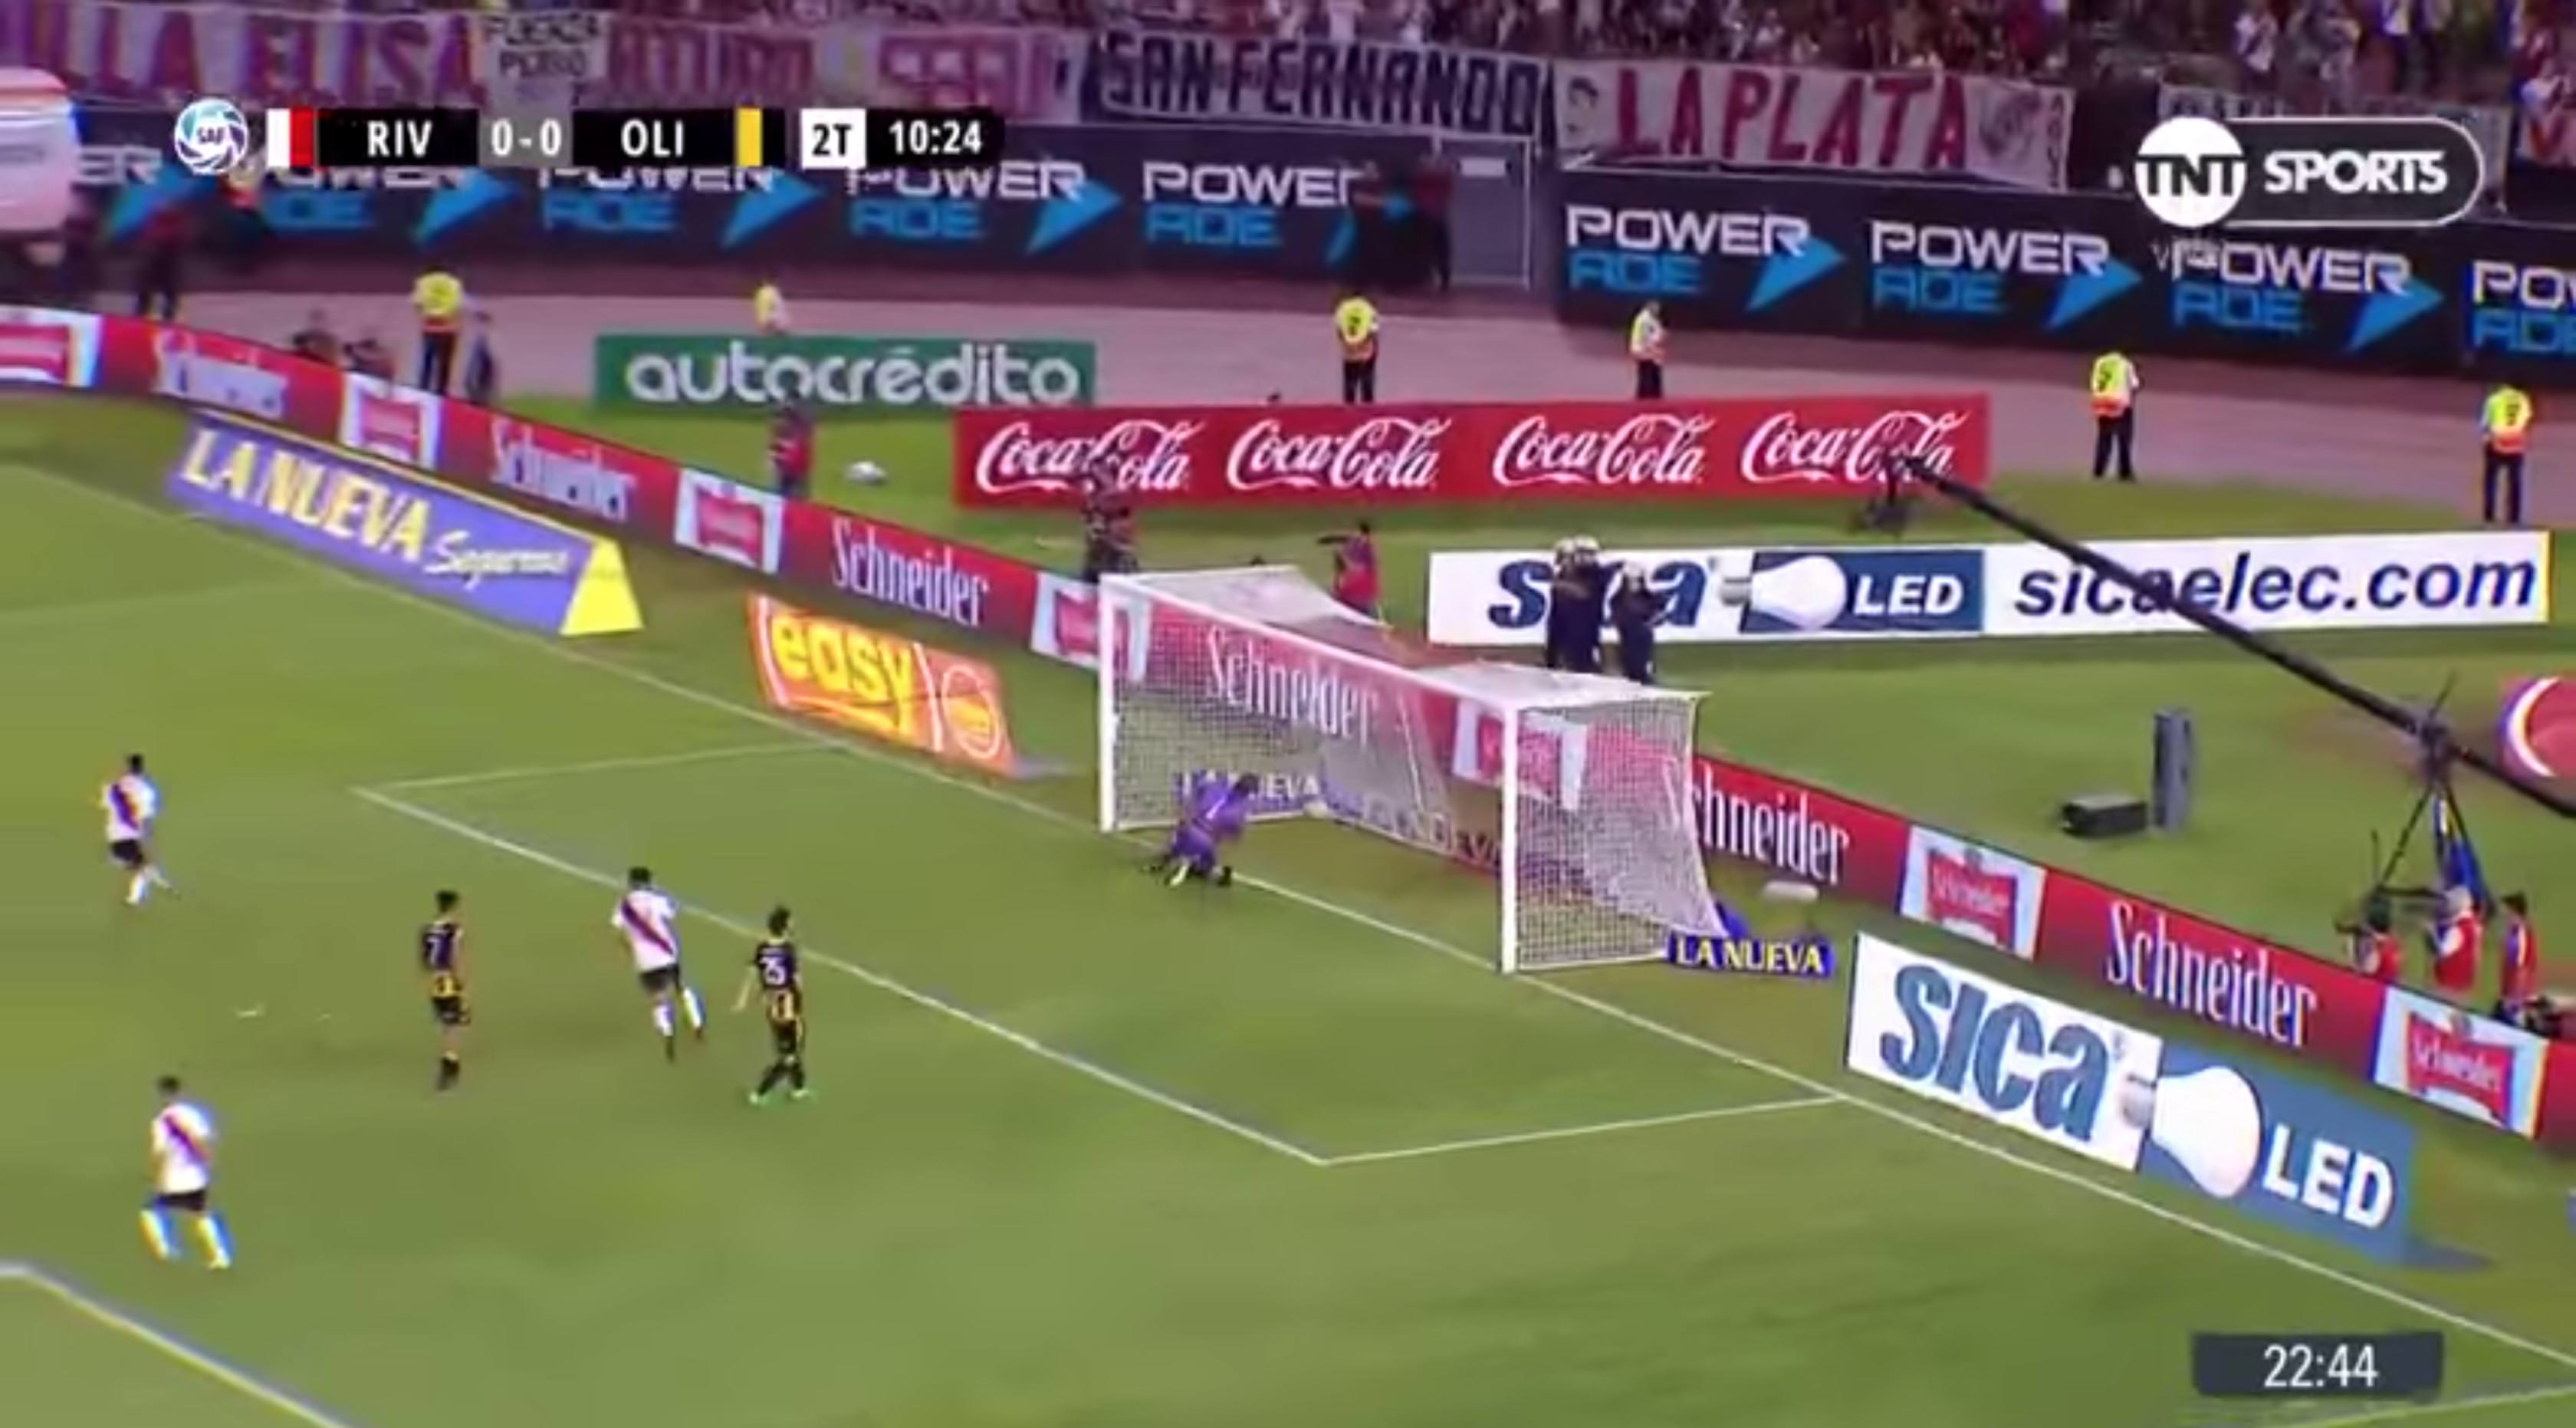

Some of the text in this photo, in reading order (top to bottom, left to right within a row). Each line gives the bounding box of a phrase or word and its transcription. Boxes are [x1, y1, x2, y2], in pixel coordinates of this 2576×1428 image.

[1228, 37, 1536, 135] FERNANDO
[1720, 71, 1966, 167] PLATA
[848, 160, 1085, 202] POWER
[1566, 205, 1811, 257] POWER
[1872, 220, 2110, 276] POWER
[2171, 236, 2411, 296] POWER
[625, 341, 1081, 403] autocrédito
[1227, 417, 1451, 491] Coca-Cola
[1492, 413, 1714, 486] Coca-Cola
[181, 428, 258, 500] LA
[256, 449, 432, 563] NUEVA
[830, 517, 991, 626] Schneider
[1852, 575, 1963, 614] LED
[2015, 552, 2539, 615] sicaelec.com
[771, 614, 914, 736] easy
[1207, 624, 1377, 745] Schneider
[1676, 939, 1823, 974] LA NUEVA
[2107, 902, 2318, 1048] Schneider
[2262, 1123, 2395, 1229] LED
